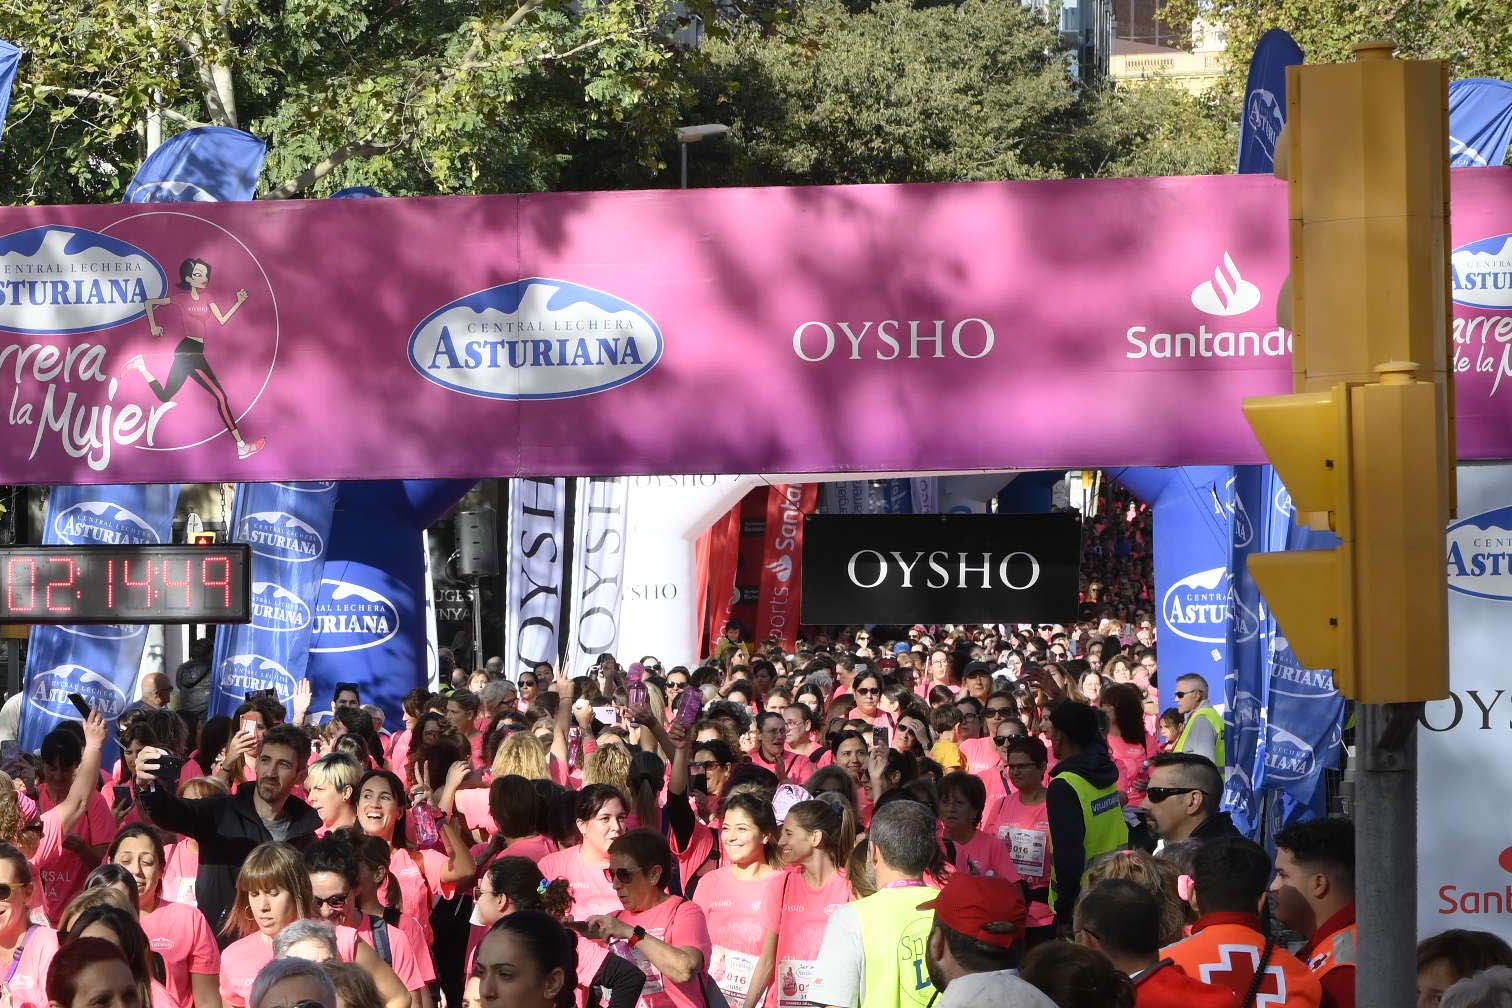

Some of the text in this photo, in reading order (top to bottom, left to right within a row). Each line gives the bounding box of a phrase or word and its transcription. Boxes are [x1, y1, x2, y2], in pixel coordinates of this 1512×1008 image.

[70, 262, 143, 274] LECHERA
[427, 325, 643, 369] ASTURIANA
[467, 319, 635, 334] CENTRAL LECHERA
[792, 317, 995, 362] OYSHO
[1476, 344, 1494, 373] la
[8, 386, 33, 425] la
[28, 376, 178, 472] Mujer
[239, 522, 317, 556] ASTURIANA
[8, 557, 230, 611] 02:14:49
[517, 476, 559, 669] OYSH
[577, 476, 621, 655] OYSH
[847, 549, 1040, 590] OYSHO
[337, 603, 385, 612] LECHERA
[631, 583, 677, 601] SHO
